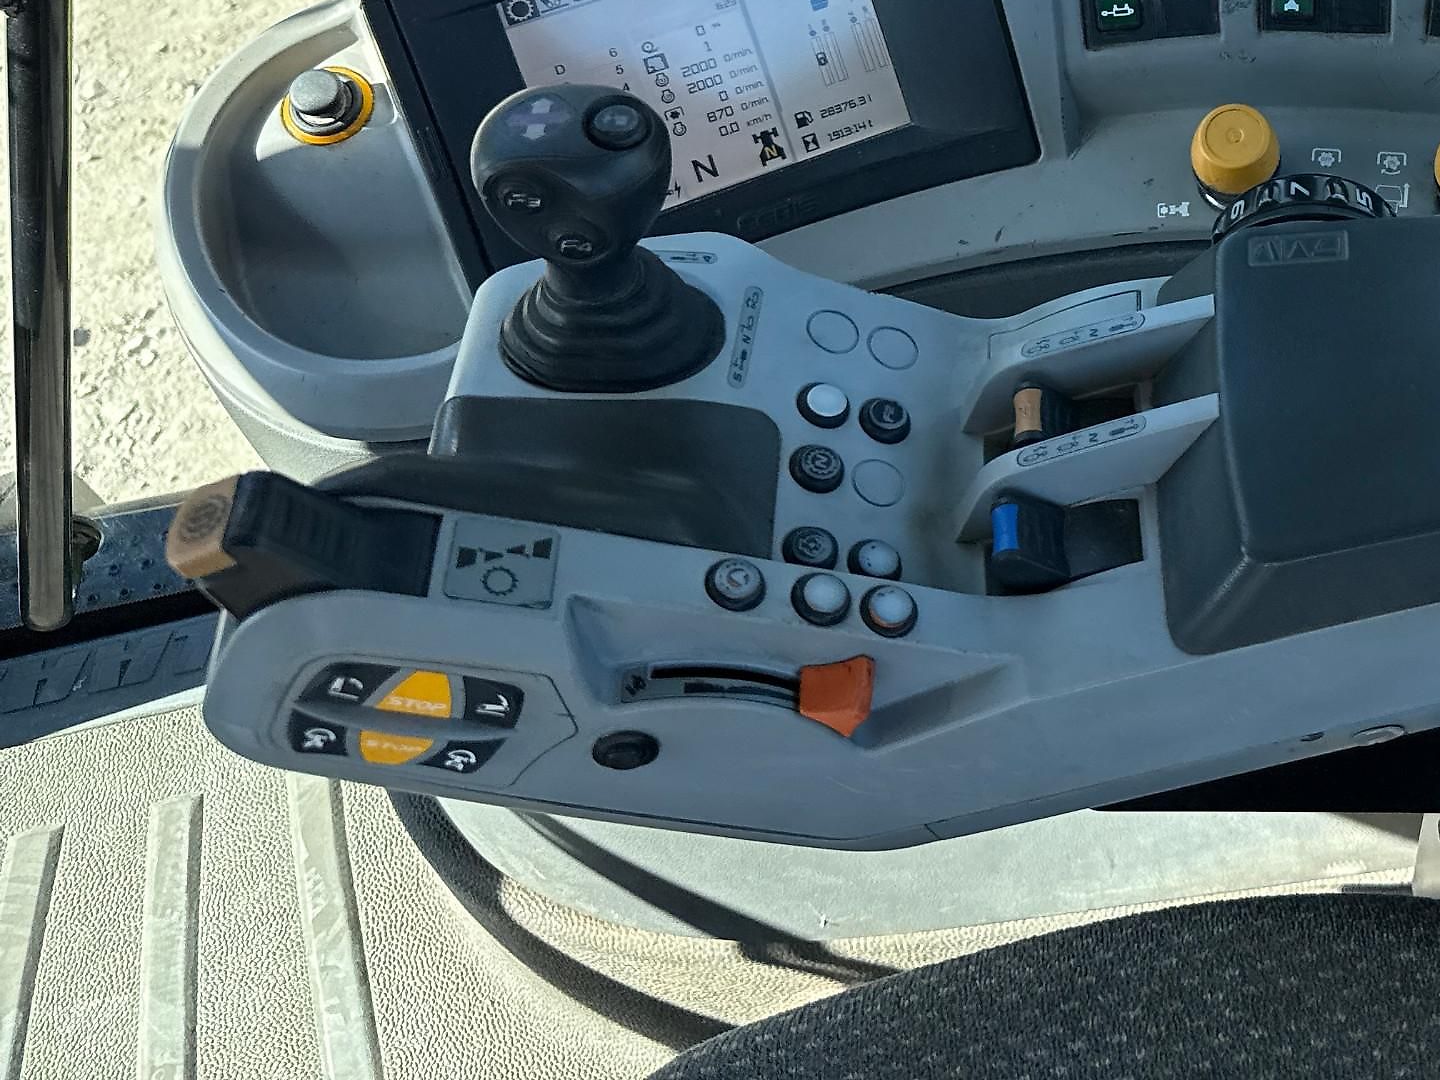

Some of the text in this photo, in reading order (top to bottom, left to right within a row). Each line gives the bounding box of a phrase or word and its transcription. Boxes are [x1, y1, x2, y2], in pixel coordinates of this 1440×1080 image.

[608, 47, 618, 58] 6
[704, 41, 713, 52] 1
[554, 64, 566, 75] D
[615, 64, 624, 75] 5
[680, 57, 717, 78] 2000
[687, 74, 723, 94] 2000
[718, 90, 729, 102] 0
[706, 105, 735, 123] 870
[691, 154, 720, 184] N
[386, 695, 448, 712] STOP
